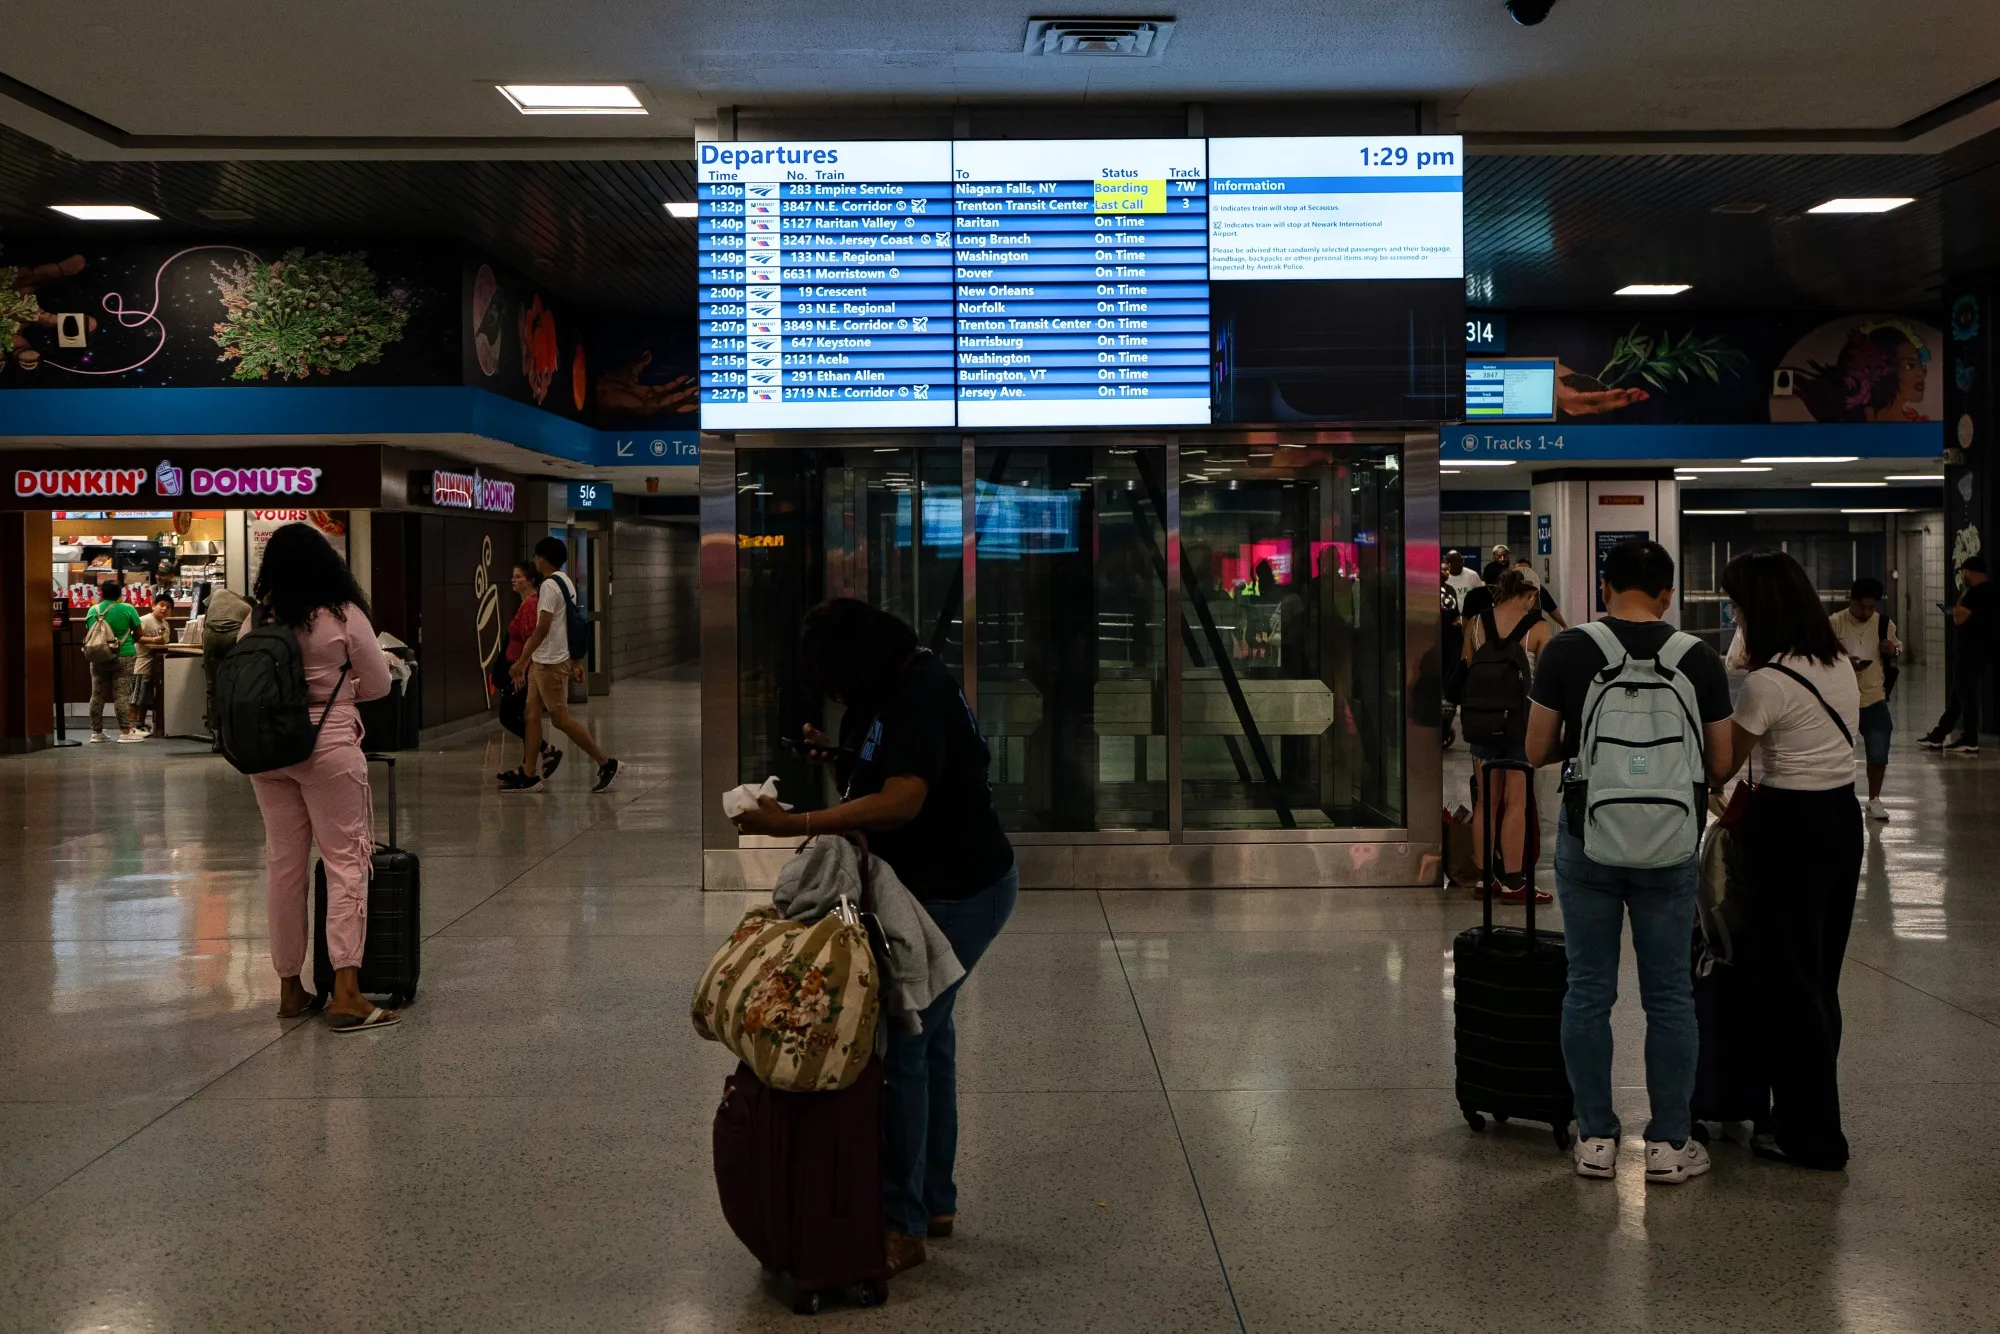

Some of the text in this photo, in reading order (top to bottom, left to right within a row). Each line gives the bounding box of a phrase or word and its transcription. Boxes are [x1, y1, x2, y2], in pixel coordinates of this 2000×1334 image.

[701, 145, 838, 169] Departures
[1360, 147, 1454, 169] 1:29 pm
[709, 168, 1200, 180] Time No. Train To Status Track
[712, 180, 1196, 197] 1:20p 283 Empire Service Niagara Falls, NY Boarding 7W
[1214, 180, 1285, 190] Information
[710, 200, 742, 214] 1:32p
[784, 200, 812, 211] 3847
[816, 200, 838, 210] N.E.
[842, 200, 892, 211] Corridor
[956, 200, 1002, 210] Trenton
[1006, 200, 1046, 210] Transit
[1050, 198, 1088, 210] Center
[1095, 200, 1118, 210] Last
[1122, 200, 1144, 210] Call
[1182, 198, 1190, 208] 3
[1283, 204, 1298, 213] stop
[710, 218, 742, 231] 1:40p
[784, 218, 812, 228] 5127
[816, 218, 858, 228] Raritan
[862, 218, 896, 231] Valley
[956, 216, 998, 227] Raritan
[1094, 216, 1112, 226] On
[1116, 216, 1144, 226] Time
[1286, 222, 1302, 230] stop
[1340, 220, 1382, 228] International
[712, 234, 744, 248] 1:43p
[784, 234, 812, 245] 3247
[816, 234, 836, 244] No.
[840, 234, 876, 248] Jersey
[880, 234, 914, 245] Coast
[958, 234, 986, 246] Long
[990, 234, 1030, 244] Branch
[1094, 232, 1112, 243] On
[1116, 232, 1144, 243] Time
[712, 248, 1146, 265] 1:49p 133 N.E. Regional Washington On Time
[1288, 246, 1320, 254] randomly
[1350, 247, 1387, 255] passengers
[1420, 246, 1452, 254] baggage,
[712, 268, 744, 282] 1:51p
[784, 268, 810, 278] 6631
[816, 268, 886, 279] Morristown
[958, 268, 992, 277] Dover
[1096, 266, 1112, 277] On
[1116, 266, 1146, 276] Time
[712, 284, 1148, 300] 2:00p 19 Crescent New Orleans On Time
[712, 300, 1148, 316] 2:02p 93 N.E. Regional Norfolk On Time
[712, 322, 744, 334] 2:07p
[784, 320, 812, 330] 3849
[816, 320, 840, 330] N.E.
[844, 320, 894, 331] Corridor
[958, 318, 1006, 329] Trenton
[1008, 318, 1048, 330] Transit
[1052, 318, 1090, 329] Center
[1098, 318, 1114, 328] On
[1118, 316, 1148, 328] Time
[712, 334, 1148, 350] 2:11p 647 Keystone Harrisburg On Time
[712, 350, 1148, 367] 2:15p 2121 Acela Washington On Time
[712, 368, 1148, 384] 2:19p 291 Ethan Allen Burlington, VT On Time
[712, 388, 744, 400] 2:27p
[786, 388, 814, 398] 3719
[818, 388, 839, 397] N.E.
[844, 388, 894, 398] Corridor
[960, 386, 996, 398] Jersey
[1000, 386, 1026, 397] Ave.
[1098, 384, 1116, 396] On
[1118, 384, 1148, 395] Time
[673, 442, 699, 456] Tra
[1485, 436, 1564, 450] Tracks 1-4
[16, 469, 314, 496] DUNKIN' DONUTS
[482, 479, 514, 512] DONUTS
[254, 510, 307, 520] YOURS
